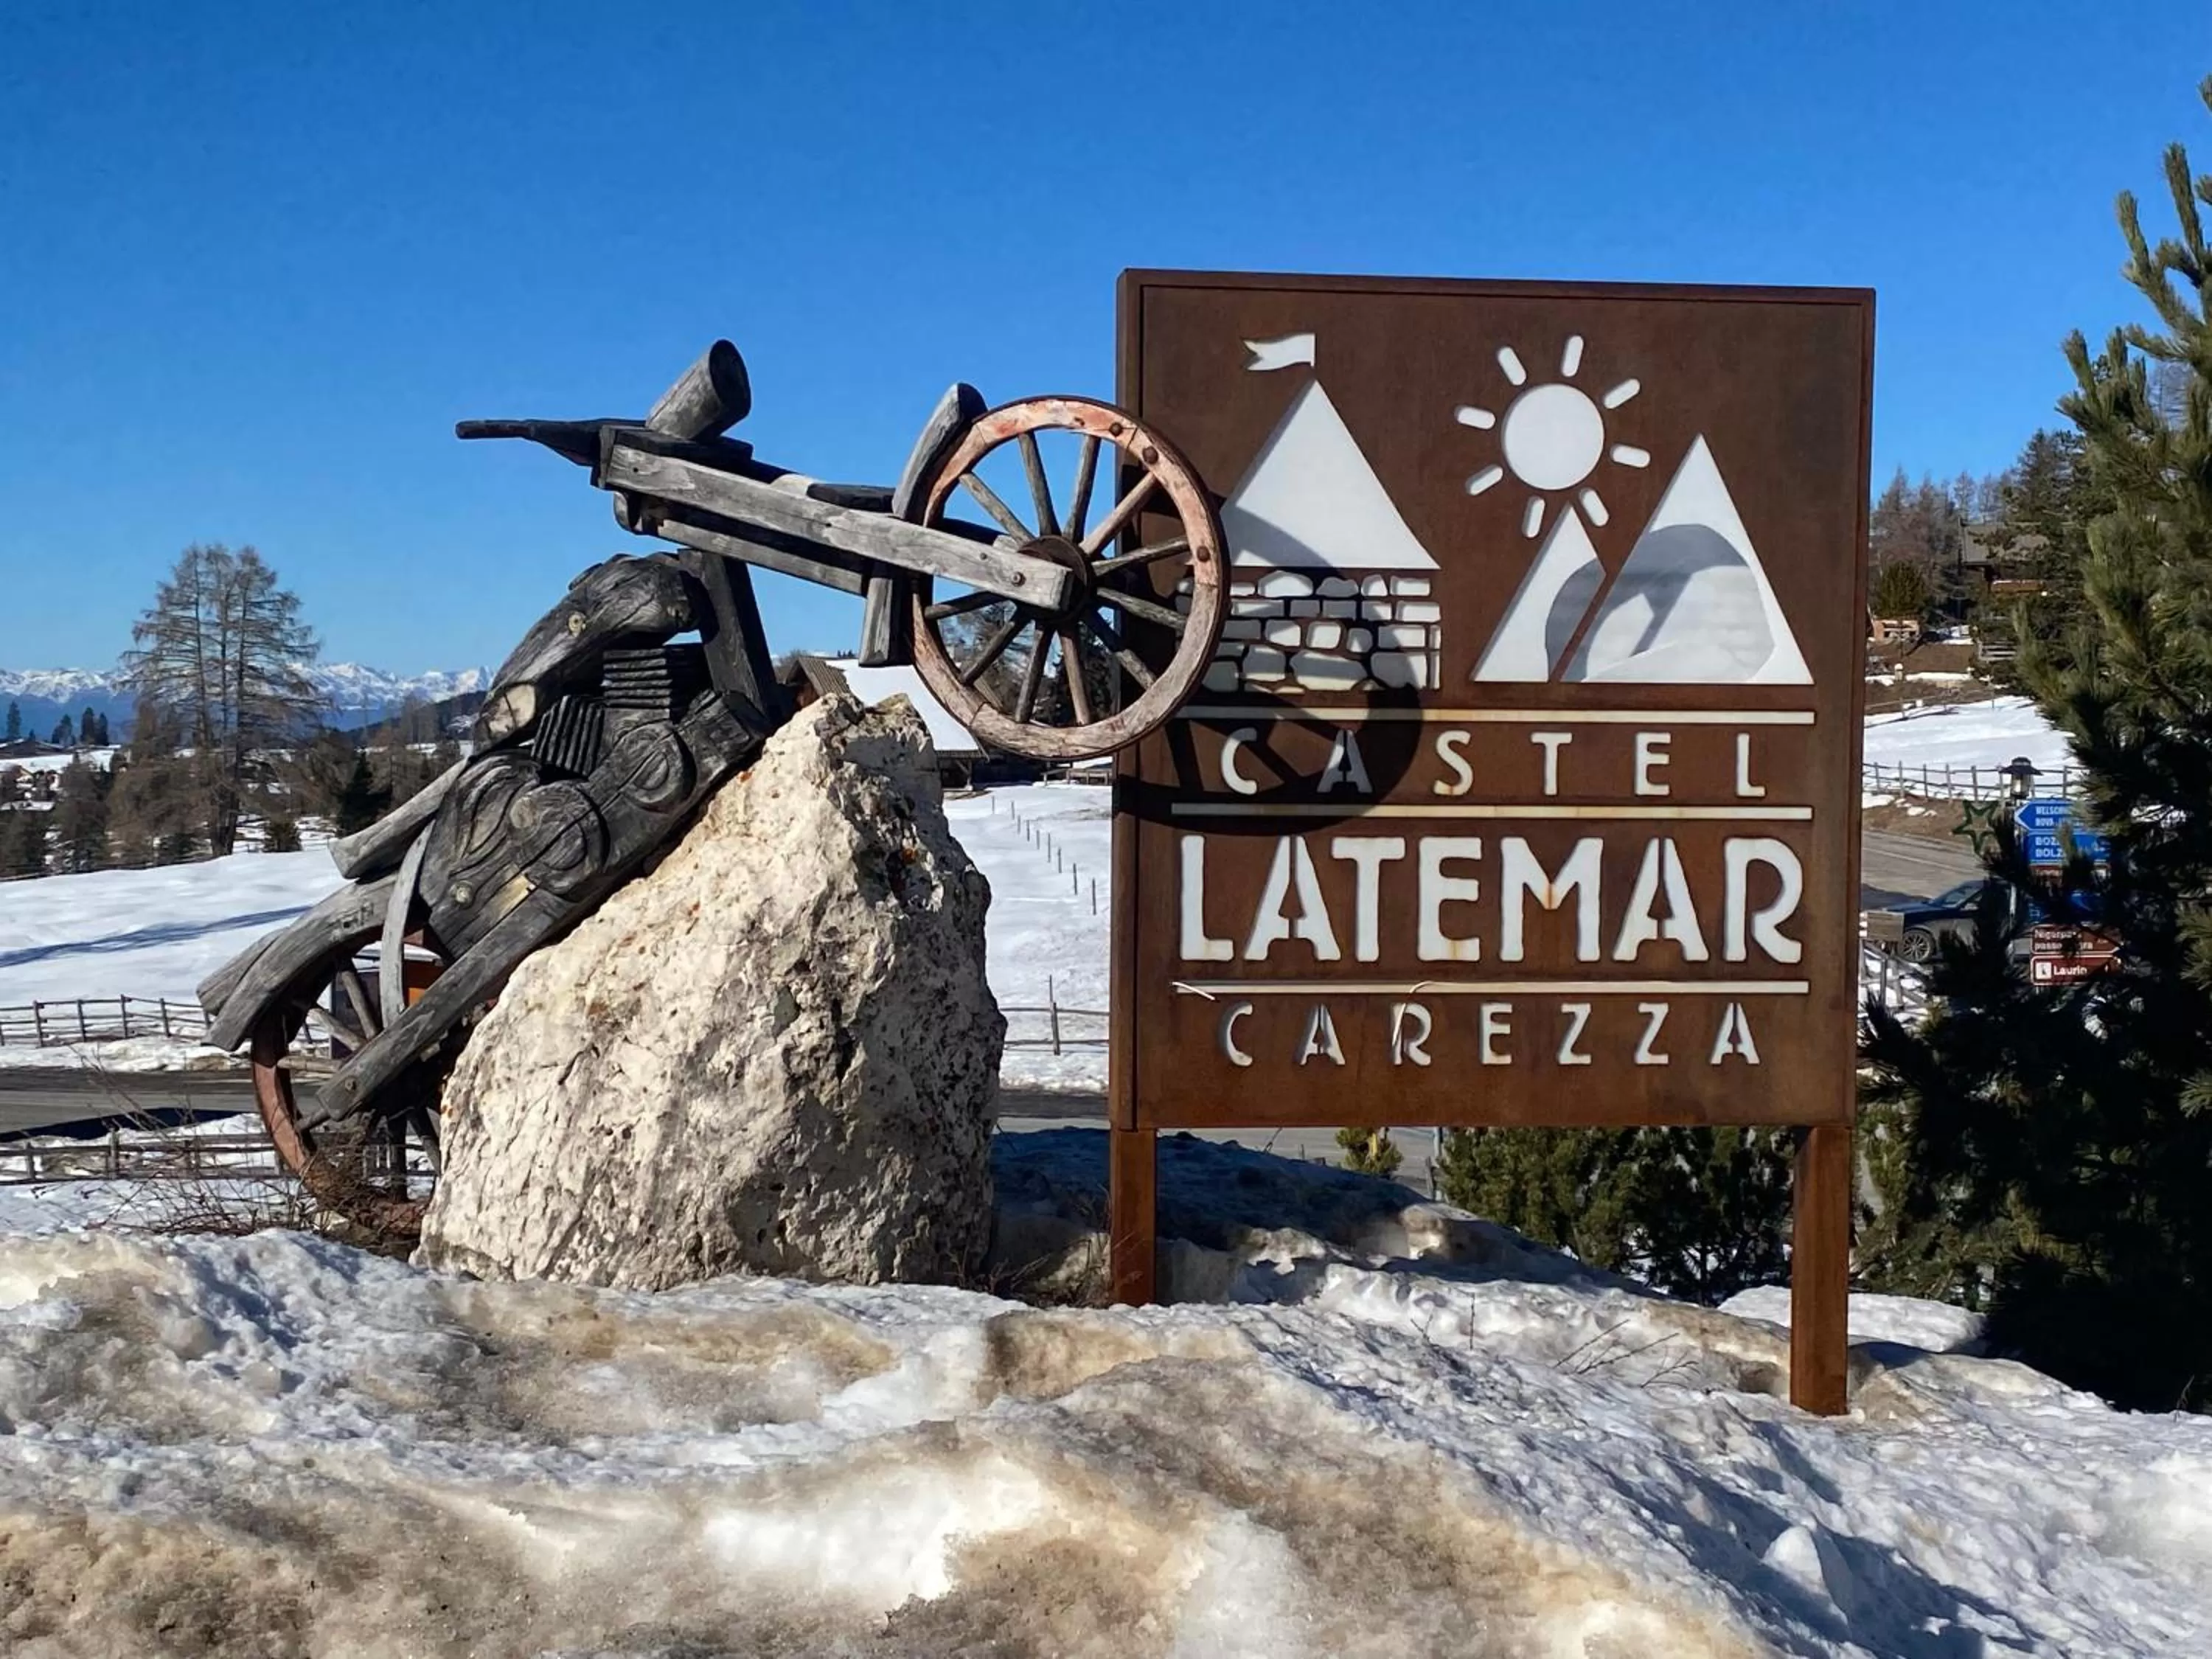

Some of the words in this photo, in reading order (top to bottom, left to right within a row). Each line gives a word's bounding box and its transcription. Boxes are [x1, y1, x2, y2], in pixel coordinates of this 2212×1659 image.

[1220, 729, 1766, 796] CASTEL
[2036, 837, 2060, 846] BOZ
[1180, 835, 1804, 963] LATEMAR
[2053, 964, 2087, 975] Laurin
[1222, 1003, 1761, 1066] CAREZZA
